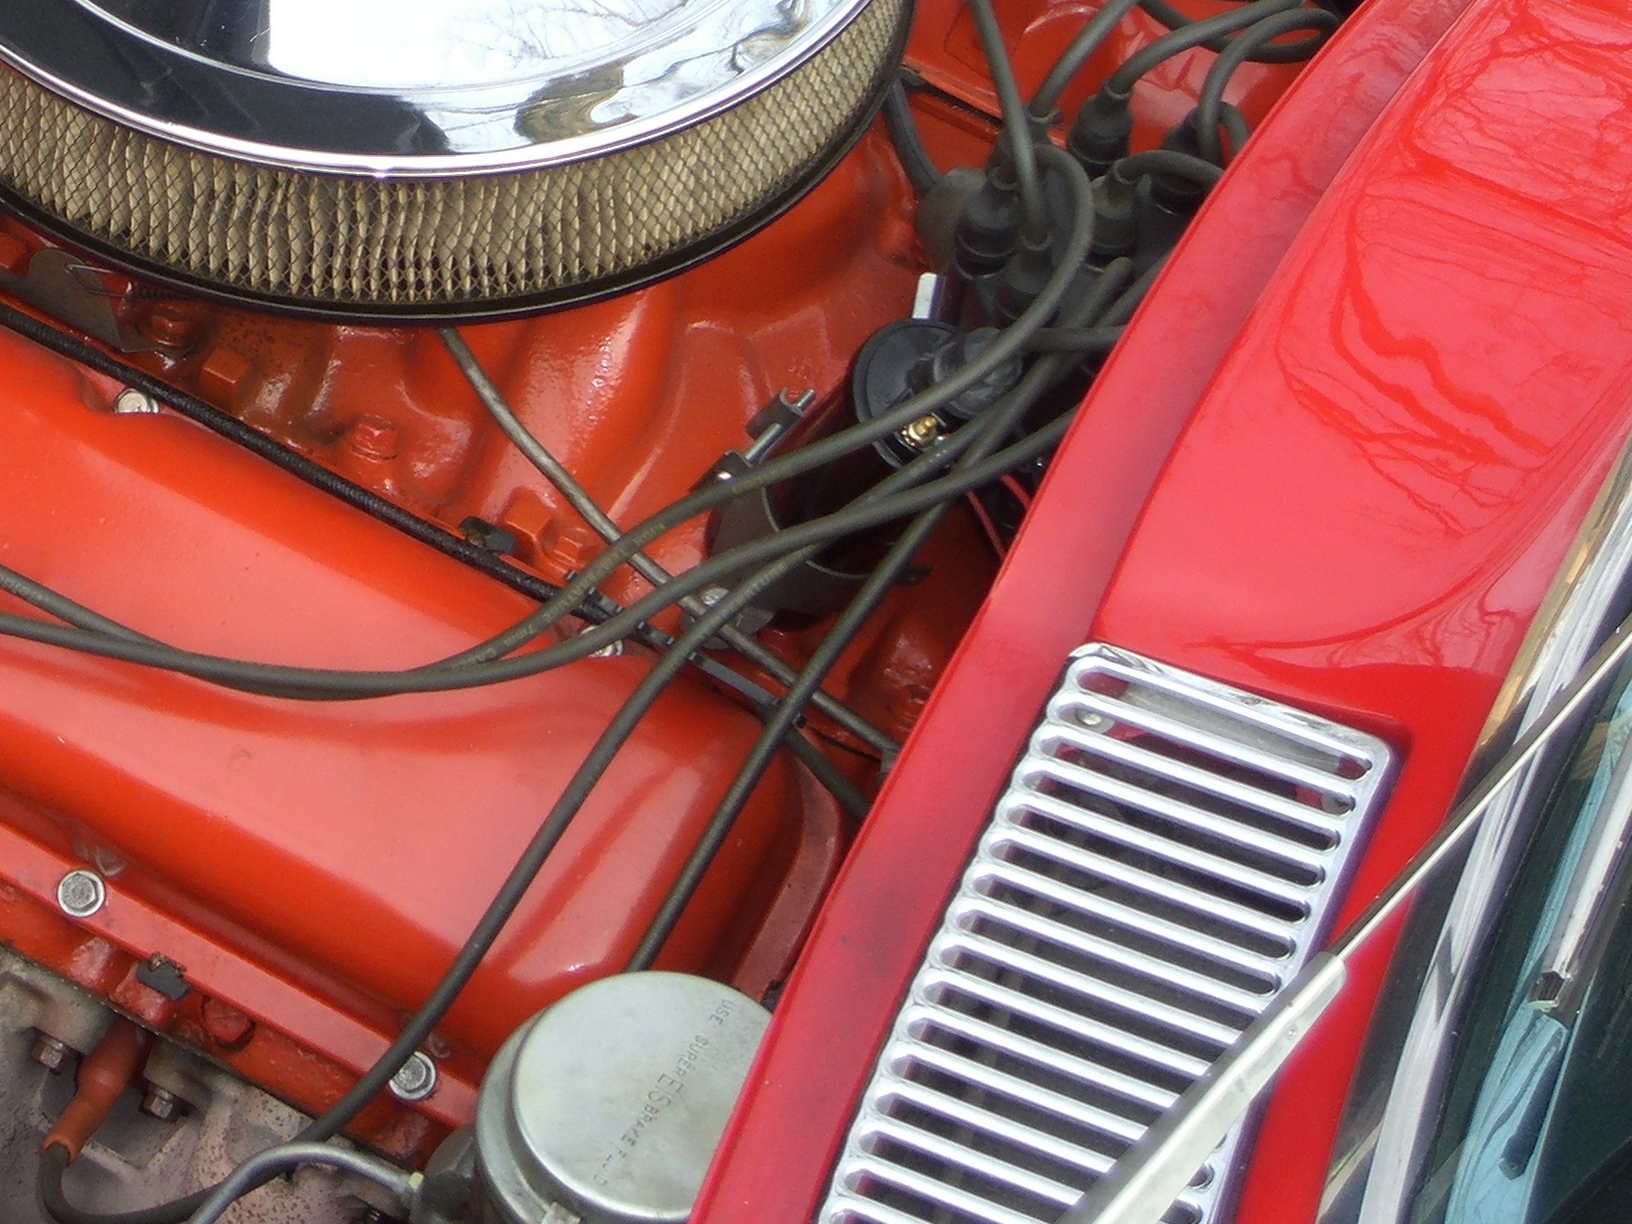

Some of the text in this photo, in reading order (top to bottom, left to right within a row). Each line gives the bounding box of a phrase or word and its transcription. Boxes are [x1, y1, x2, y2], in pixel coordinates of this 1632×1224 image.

[709, 999, 735, 1026] USE
[676, 1034, 710, 1076] SUPER
[621, 1103, 660, 1147] BRAKE
